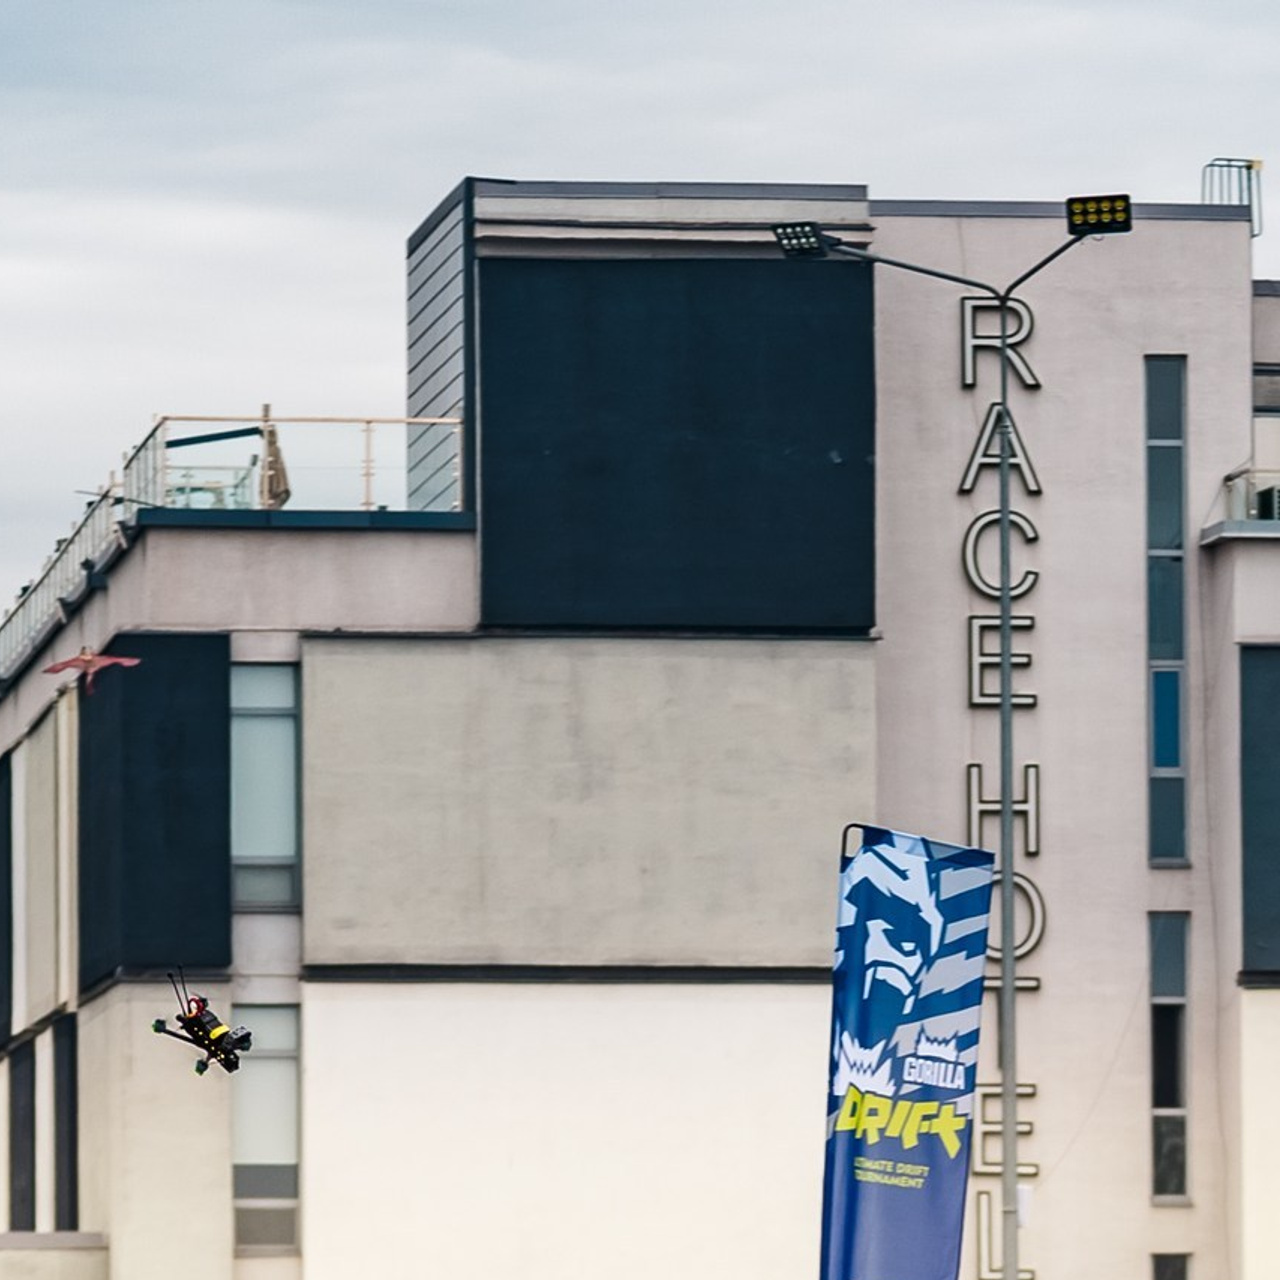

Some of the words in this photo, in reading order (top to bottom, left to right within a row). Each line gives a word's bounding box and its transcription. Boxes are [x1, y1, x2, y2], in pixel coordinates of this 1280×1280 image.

[957, 296, 1042, 709] RACE
[903, 1057, 966, 1090] GORILLA
[835, 1083, 967, 1159] DRIFT
